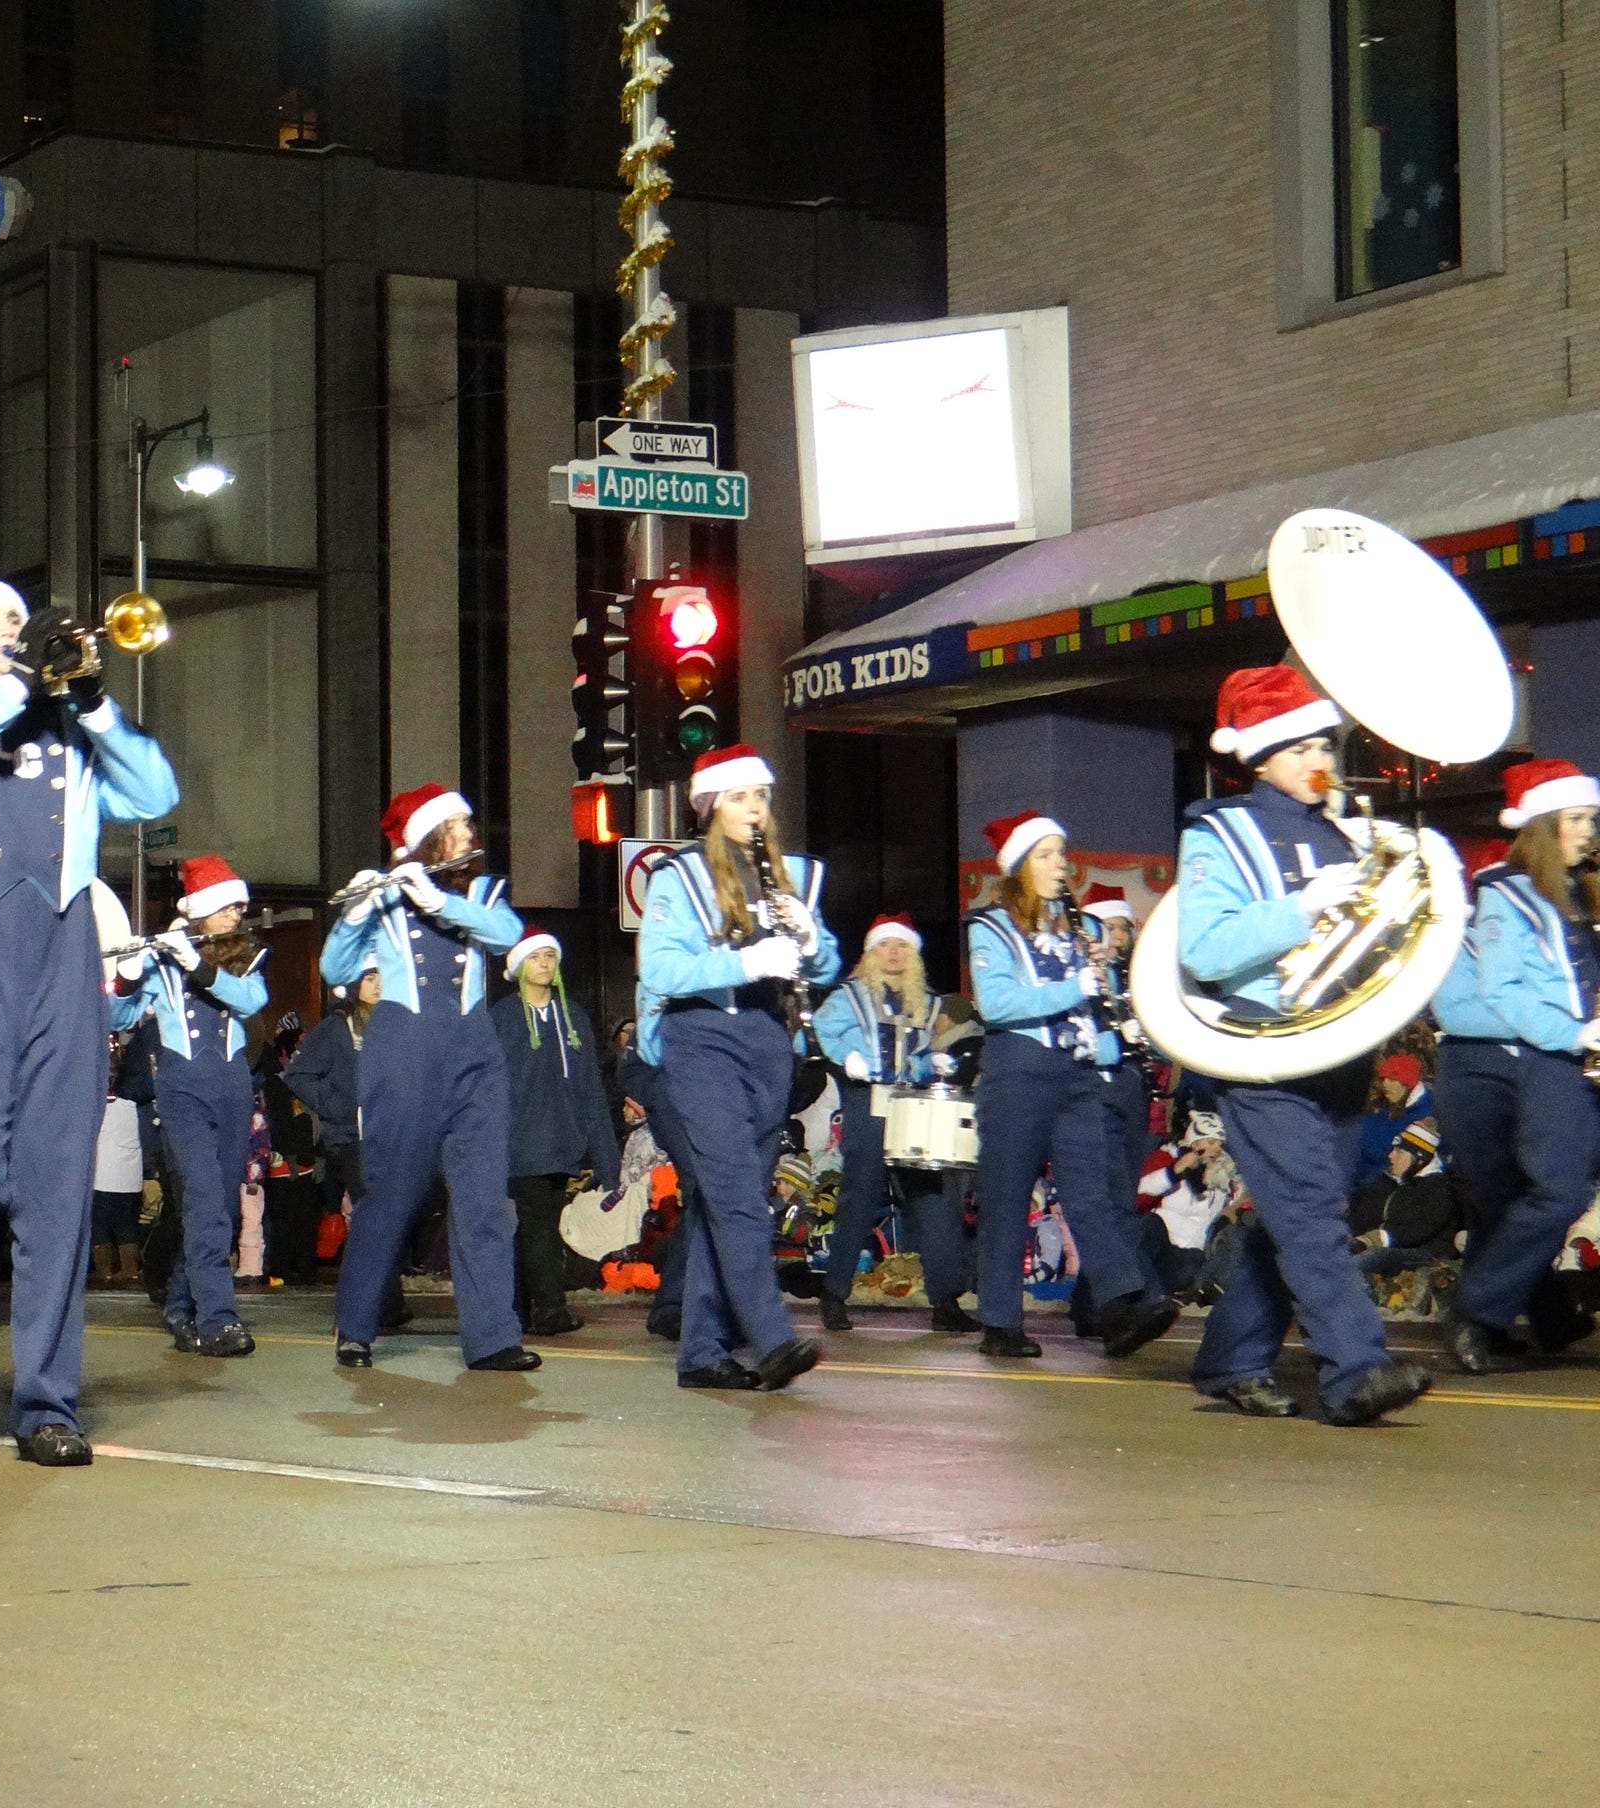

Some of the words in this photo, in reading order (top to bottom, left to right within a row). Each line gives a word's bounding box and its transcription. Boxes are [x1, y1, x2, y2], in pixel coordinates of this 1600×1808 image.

[632, 434, 664, 452] ONE
[669, 436, 703, 455] WAY
[603, 468, 708, 506] Appleton
[715, 477, 741, 507] St
[791, 660, 846, 704] FOR
[851, 641, 931, 691] KIDS
